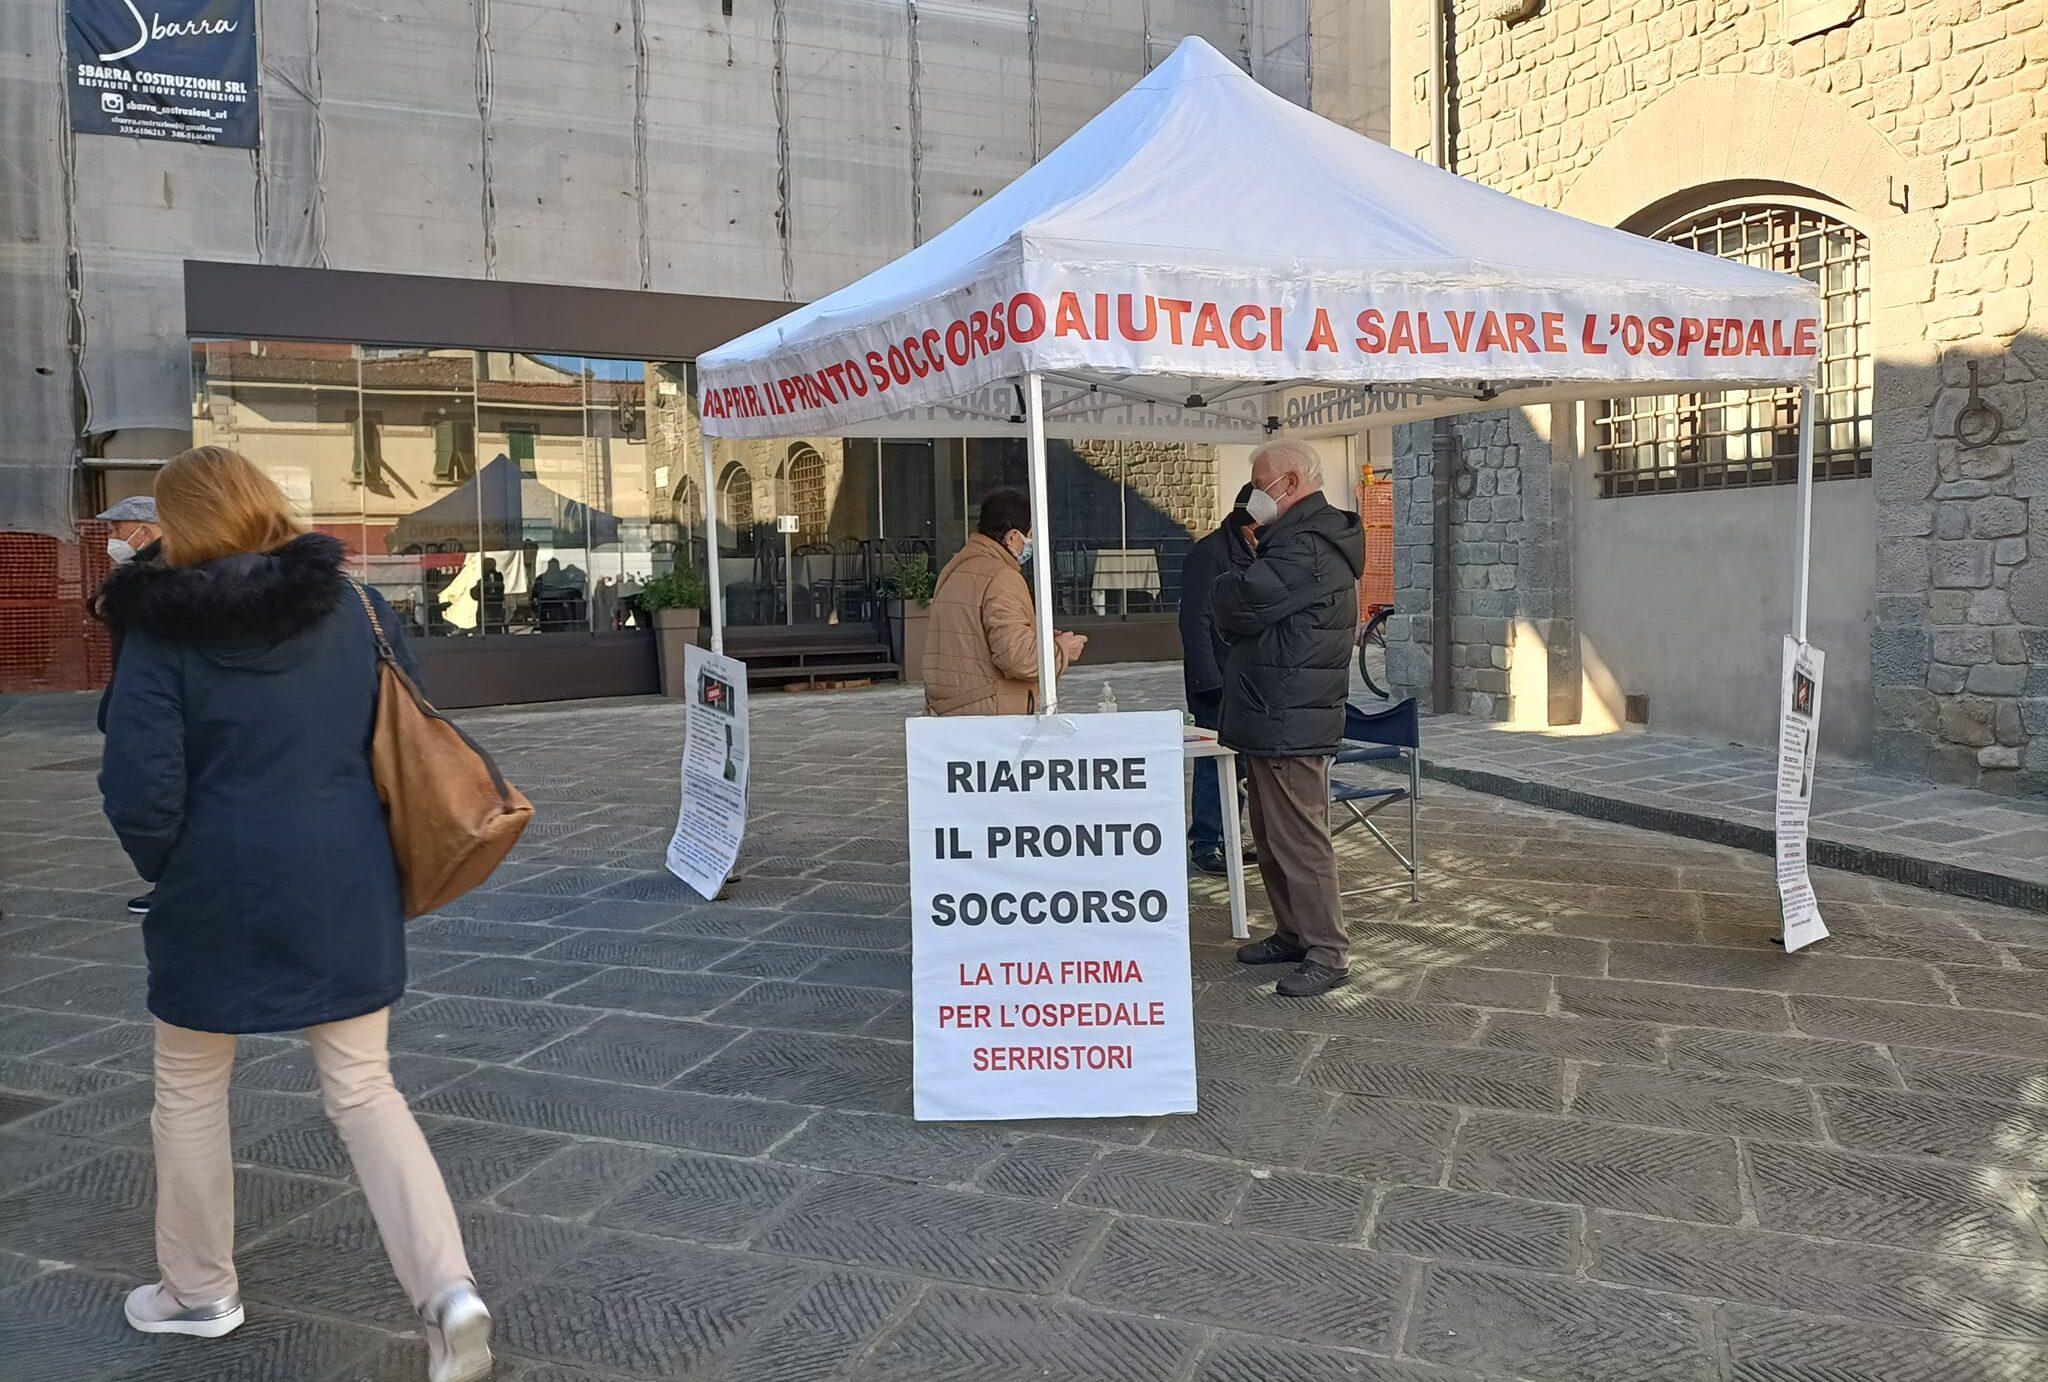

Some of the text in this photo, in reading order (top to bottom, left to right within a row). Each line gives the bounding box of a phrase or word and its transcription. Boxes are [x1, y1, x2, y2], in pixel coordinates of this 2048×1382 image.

[78, 64, 247, 94] SBARRA COSTRUZIONI SRL
[78, 77, 246, 103] RESTAURI E NUOVE COSTRUZIONI
[1055, 291, 1817, 357] AIUTACI A SALVARE L'OSPEDALE
[778, 359, 868, 413] PRONTO
[866, 292, 1046, 392] SOCCORSO
[946, 757, 1147, 793] RIAPRIRE
[934, 822, 1162, 859] IL PRONTO
[931, 889, 1168, 926] SOCCORSO
[959, 960, 1143, 986] LA TUA FIRMA
[939, 1002, 1165, 1029] PER L'OSPEDALE
[972, 1046, 1133, 1072] SERRISTORI
